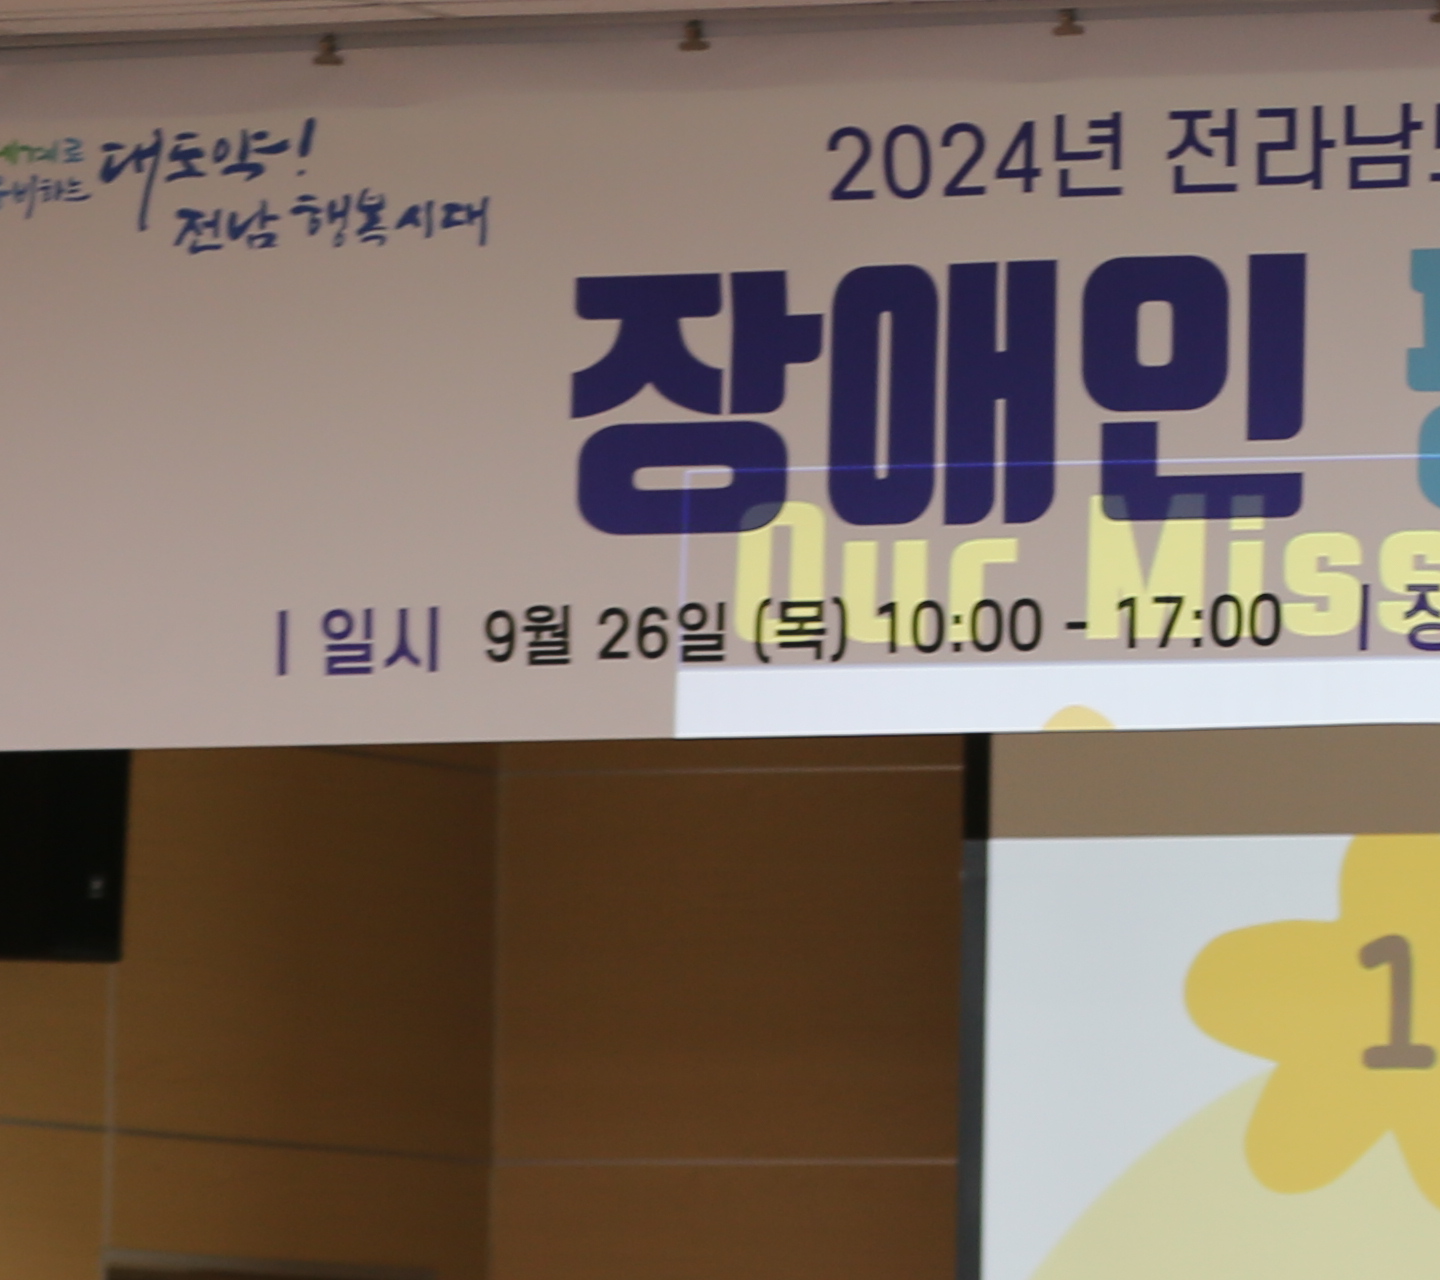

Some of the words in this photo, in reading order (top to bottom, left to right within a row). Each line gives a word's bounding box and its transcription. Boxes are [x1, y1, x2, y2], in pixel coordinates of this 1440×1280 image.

[825, 110, 1126, 202] 2024년
[172, 199, 282, 255] 전남
[570, 251, 1309, 536] 장애인
[320, 605, 441, 675] 일시
[482, 604, 574, 667] 9월
[596, 602, 730, 664] 26일
[754, 595, 849, 665] (목)
[875, 597, 1043, 655] 10:00
[1115, 591, 1283, 652] 17:00
[1356, 932, 1438, 1071] 1
